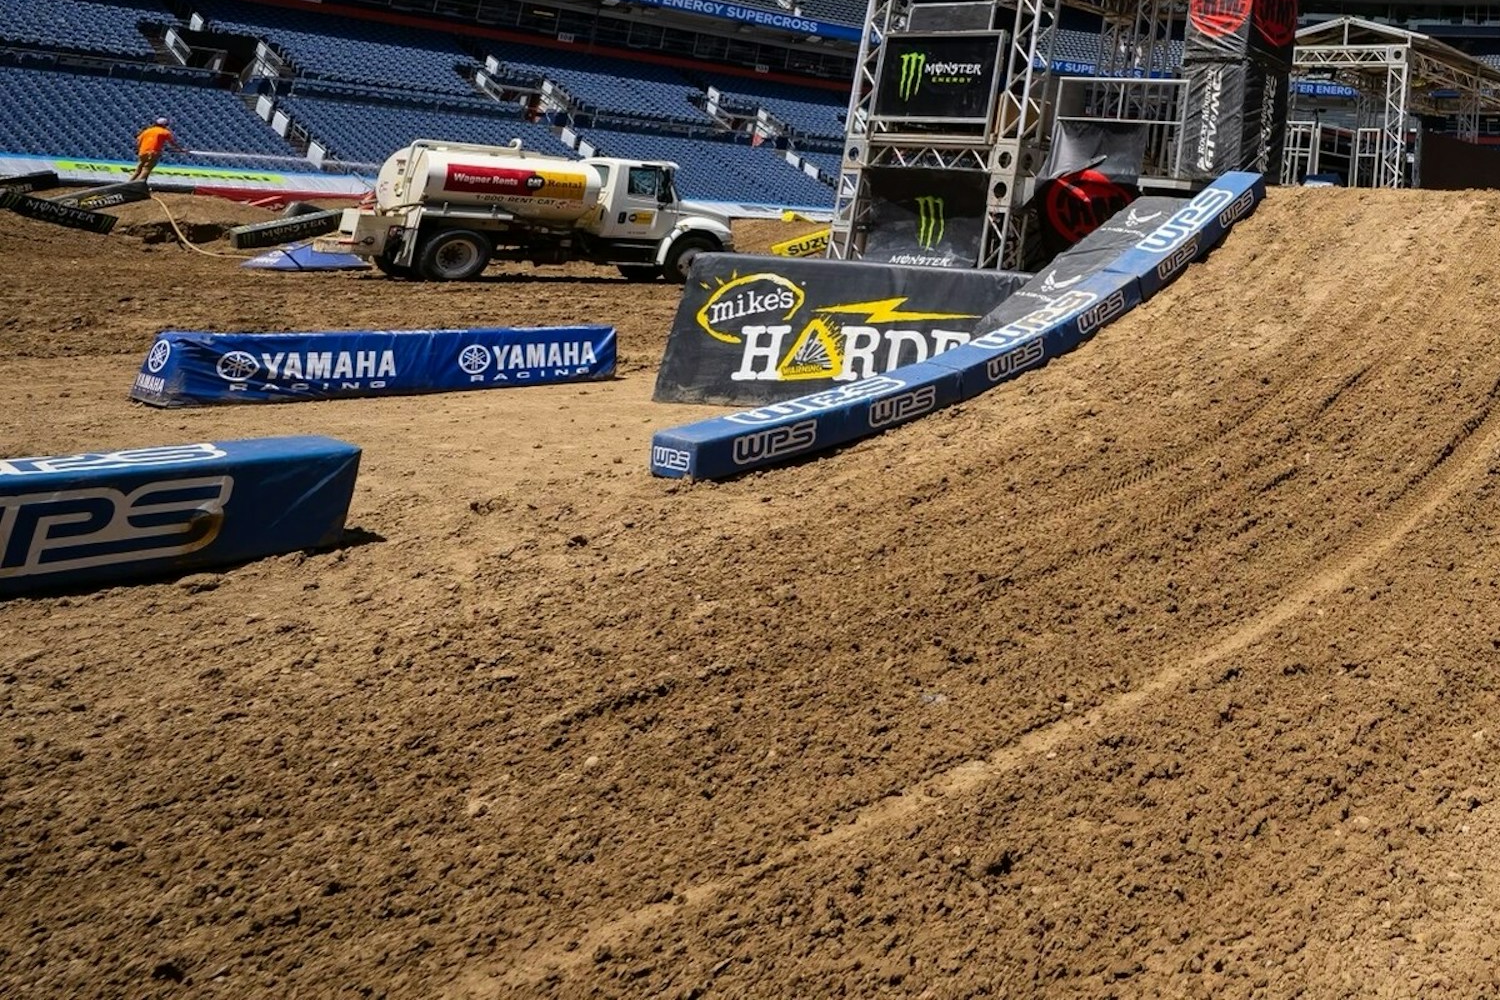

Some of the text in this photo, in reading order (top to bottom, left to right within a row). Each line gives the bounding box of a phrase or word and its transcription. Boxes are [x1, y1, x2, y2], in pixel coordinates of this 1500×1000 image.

[726, 5, 818, 33] SUPERCROSS
[925, 62, 982, 76] MONSTER
[932, 76, 972, 84] ENERGY
[1198, 122, 1207, 154] ROCKY
[454, 173, 582, 189] Wagner Rents CAT Rental
[26, 199, 96, 224] MONSTER
[787, 235, 831, 257] SUZU
[889, 255, 951, 267] MONSTER
[710, 287, 795, 324] mike's
[261, 348, 397, 380] YAMAHA
[491, 341, 597, 369] YAMAHA
[987, 337, 1044, 382] WPS
[135, 375, 165, 393] YAMAHA
[228, 380, 388, 392] RACING
[469, 366, 591, 382] RACING
[868, 385, 936, 429] WPS
[733, 418, 817, 465] WPS
[652, 446, 691, 471] WPS
[0, 475, 234, 578] PS
